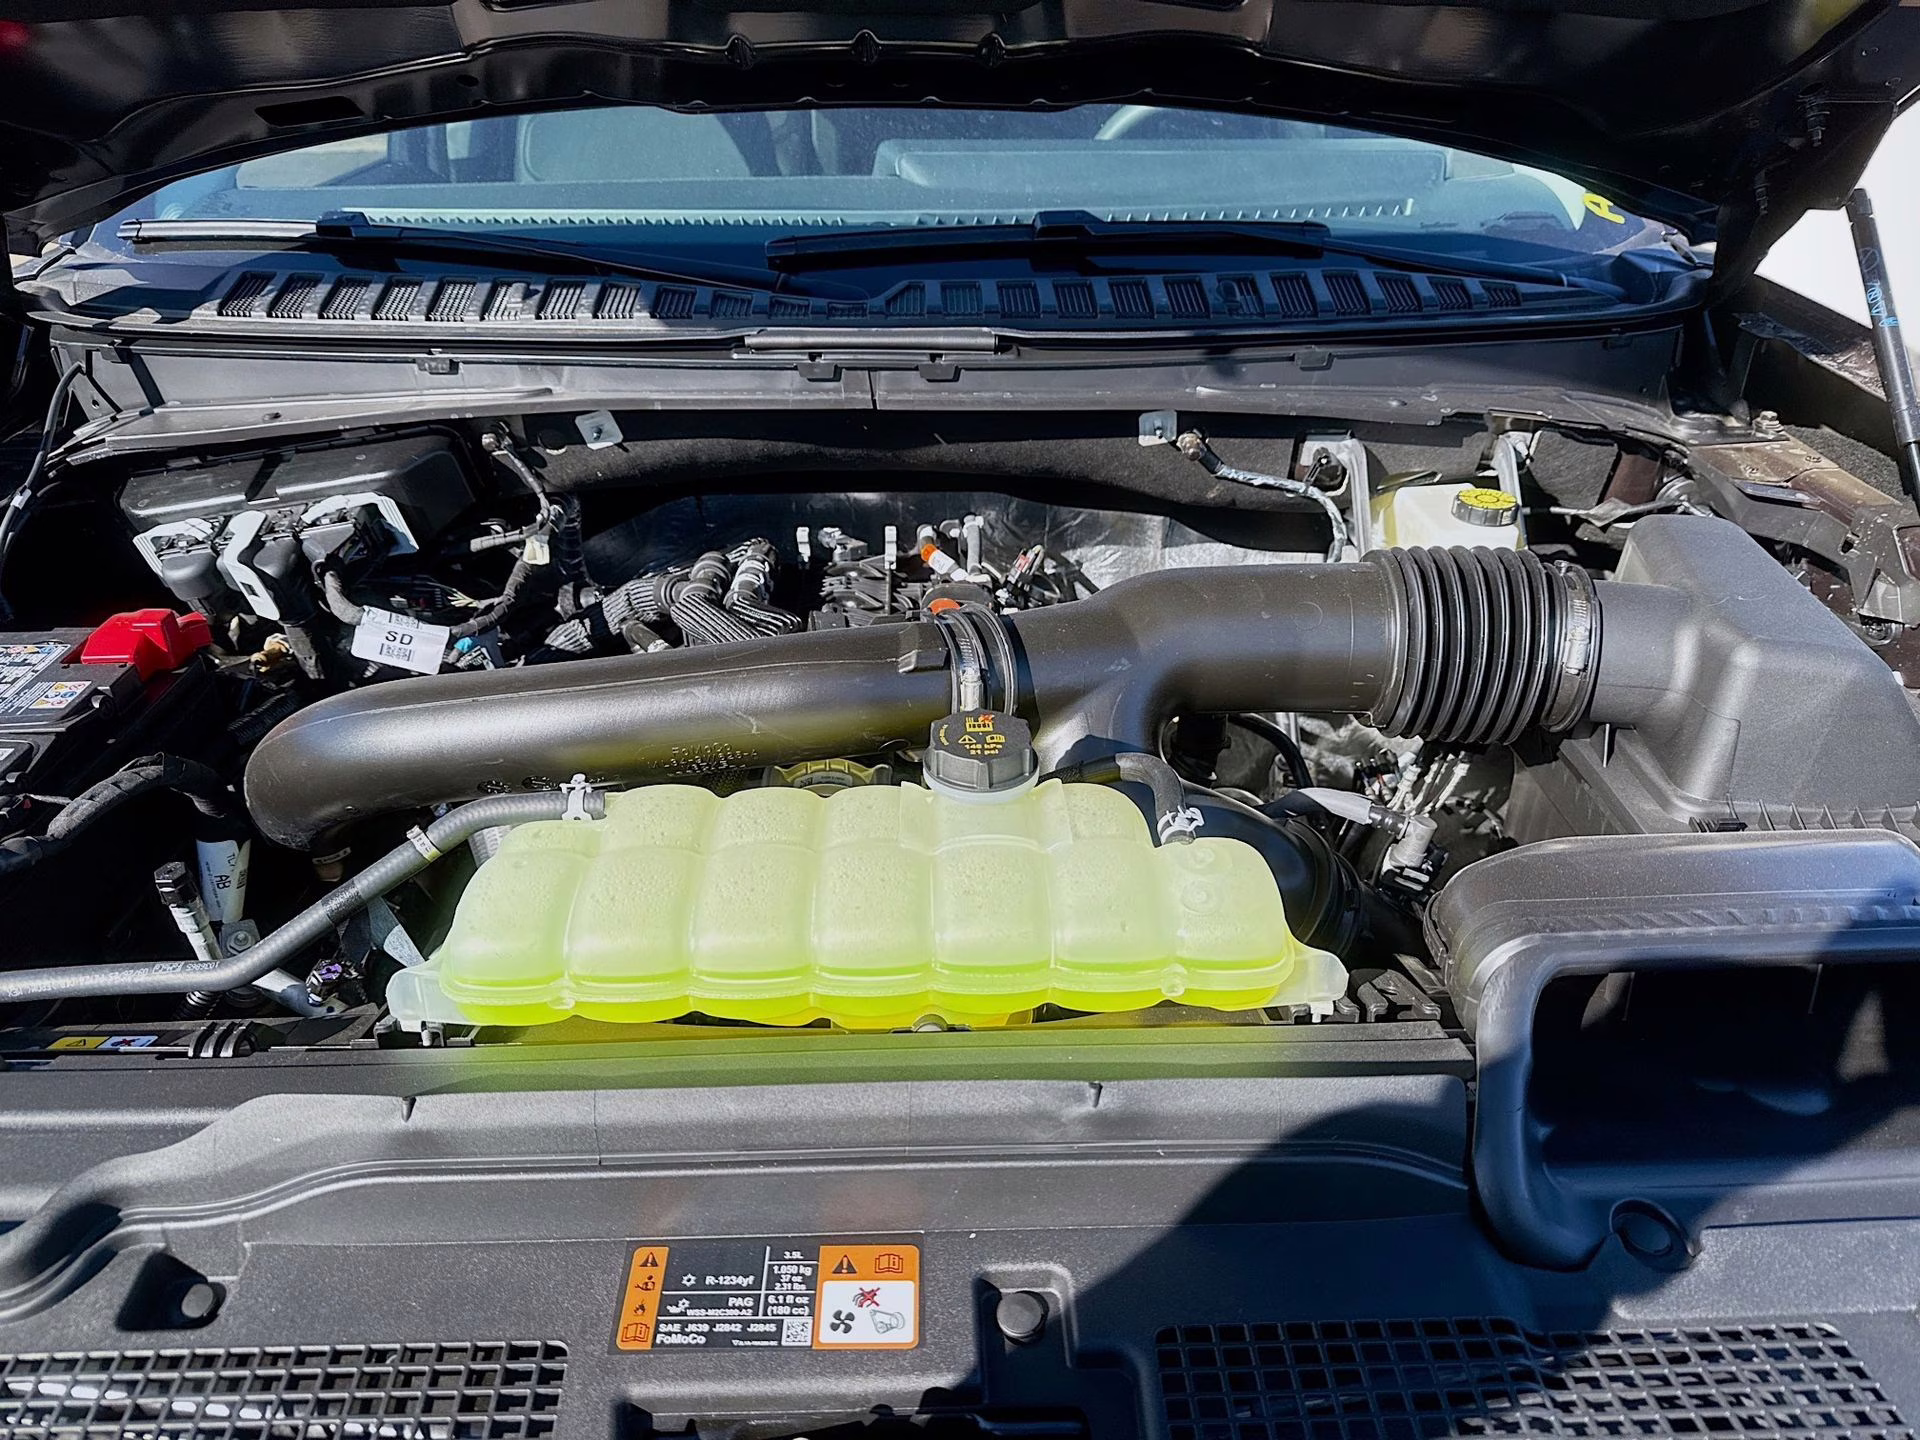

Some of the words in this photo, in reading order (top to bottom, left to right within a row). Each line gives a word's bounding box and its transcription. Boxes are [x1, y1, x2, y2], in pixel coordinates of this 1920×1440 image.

[385, 630, 414, 646] SD
[213, 874, 232, 890] AB
[783, 1251, 804, 1259] 3.5L
[772, 1264, 798, 1275] 1.050
[799, 1264, 813, 1277] kg
[705, 1275, 755, 1287] R-1234yf
[780, 1274, 792, 1283] 37
[791, 1275, 804, 1283] oz
[774, 1282, 792, 1291] 2.31
[792, 1282, 807, 1291] lbs
[728, 1297, 755, 1307] PAG
[767, 1294, 785, 1304] 6.1
[785, 1294, 795, 1304] fl
[795, 1296, 810, 1304] oz
[767, 1305, 791, 1317] (180
[791, 1305, 810, 1317] cc)
[658, 1323, 682, 1333] SAE
[684, 1323, 710, 1333] J639
[712, 1323, 743, 1333] J2842
[746, 1323, 778, 1333] J2845
[655, 1333, 707, 1345] FoMoCo
